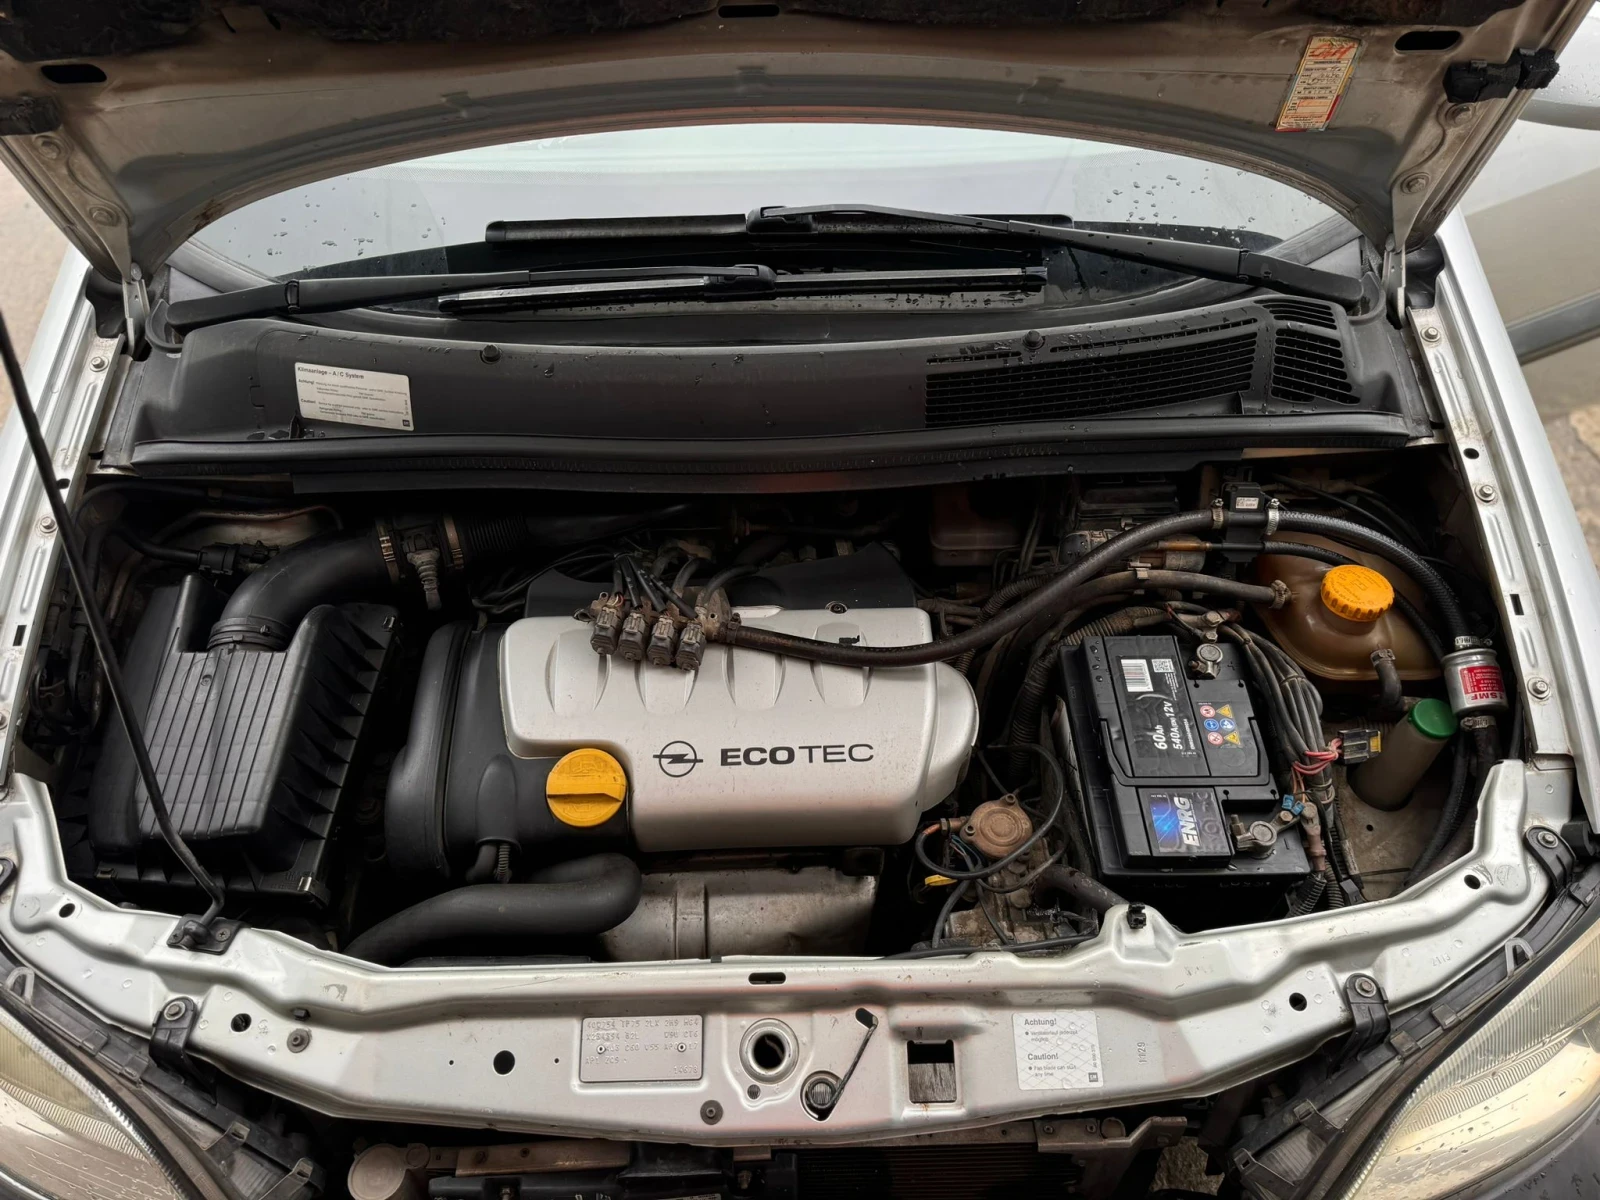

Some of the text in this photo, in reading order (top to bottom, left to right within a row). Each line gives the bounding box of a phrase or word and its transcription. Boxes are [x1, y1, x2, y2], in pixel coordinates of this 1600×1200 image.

[298, 367, 327, 375] Klimaanlage
[1163, 701, 1178, 717] 12V
[1153, 724, 1168, 750] 60Ah
[721, 743, 874, 766] ECOTEC
[1174, 797, 1200, 846] ENRG
[1024, 1018, 1057, 1027] Achtung!
